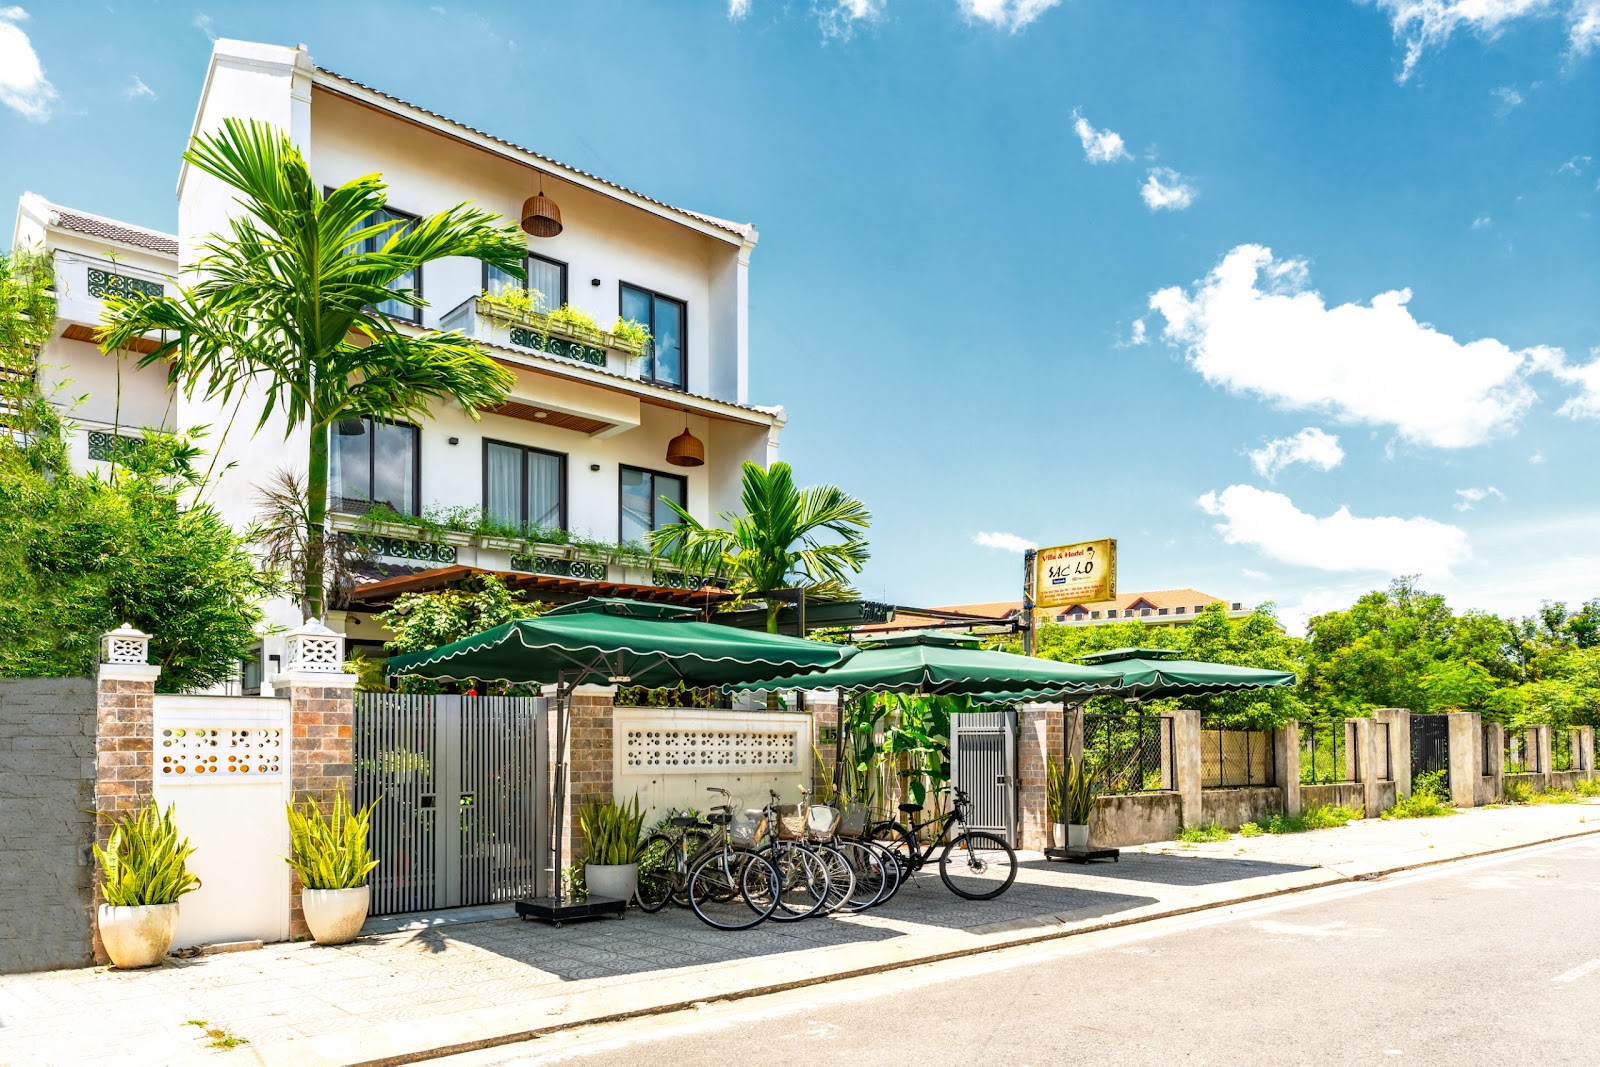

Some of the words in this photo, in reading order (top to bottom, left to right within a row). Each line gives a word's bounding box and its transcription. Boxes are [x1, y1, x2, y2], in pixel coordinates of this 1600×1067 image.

[1042, 553, 1057, 561] Villa
[1065, 549, 1084, 558] Hostel
[825, 729, 837, 739] 15
